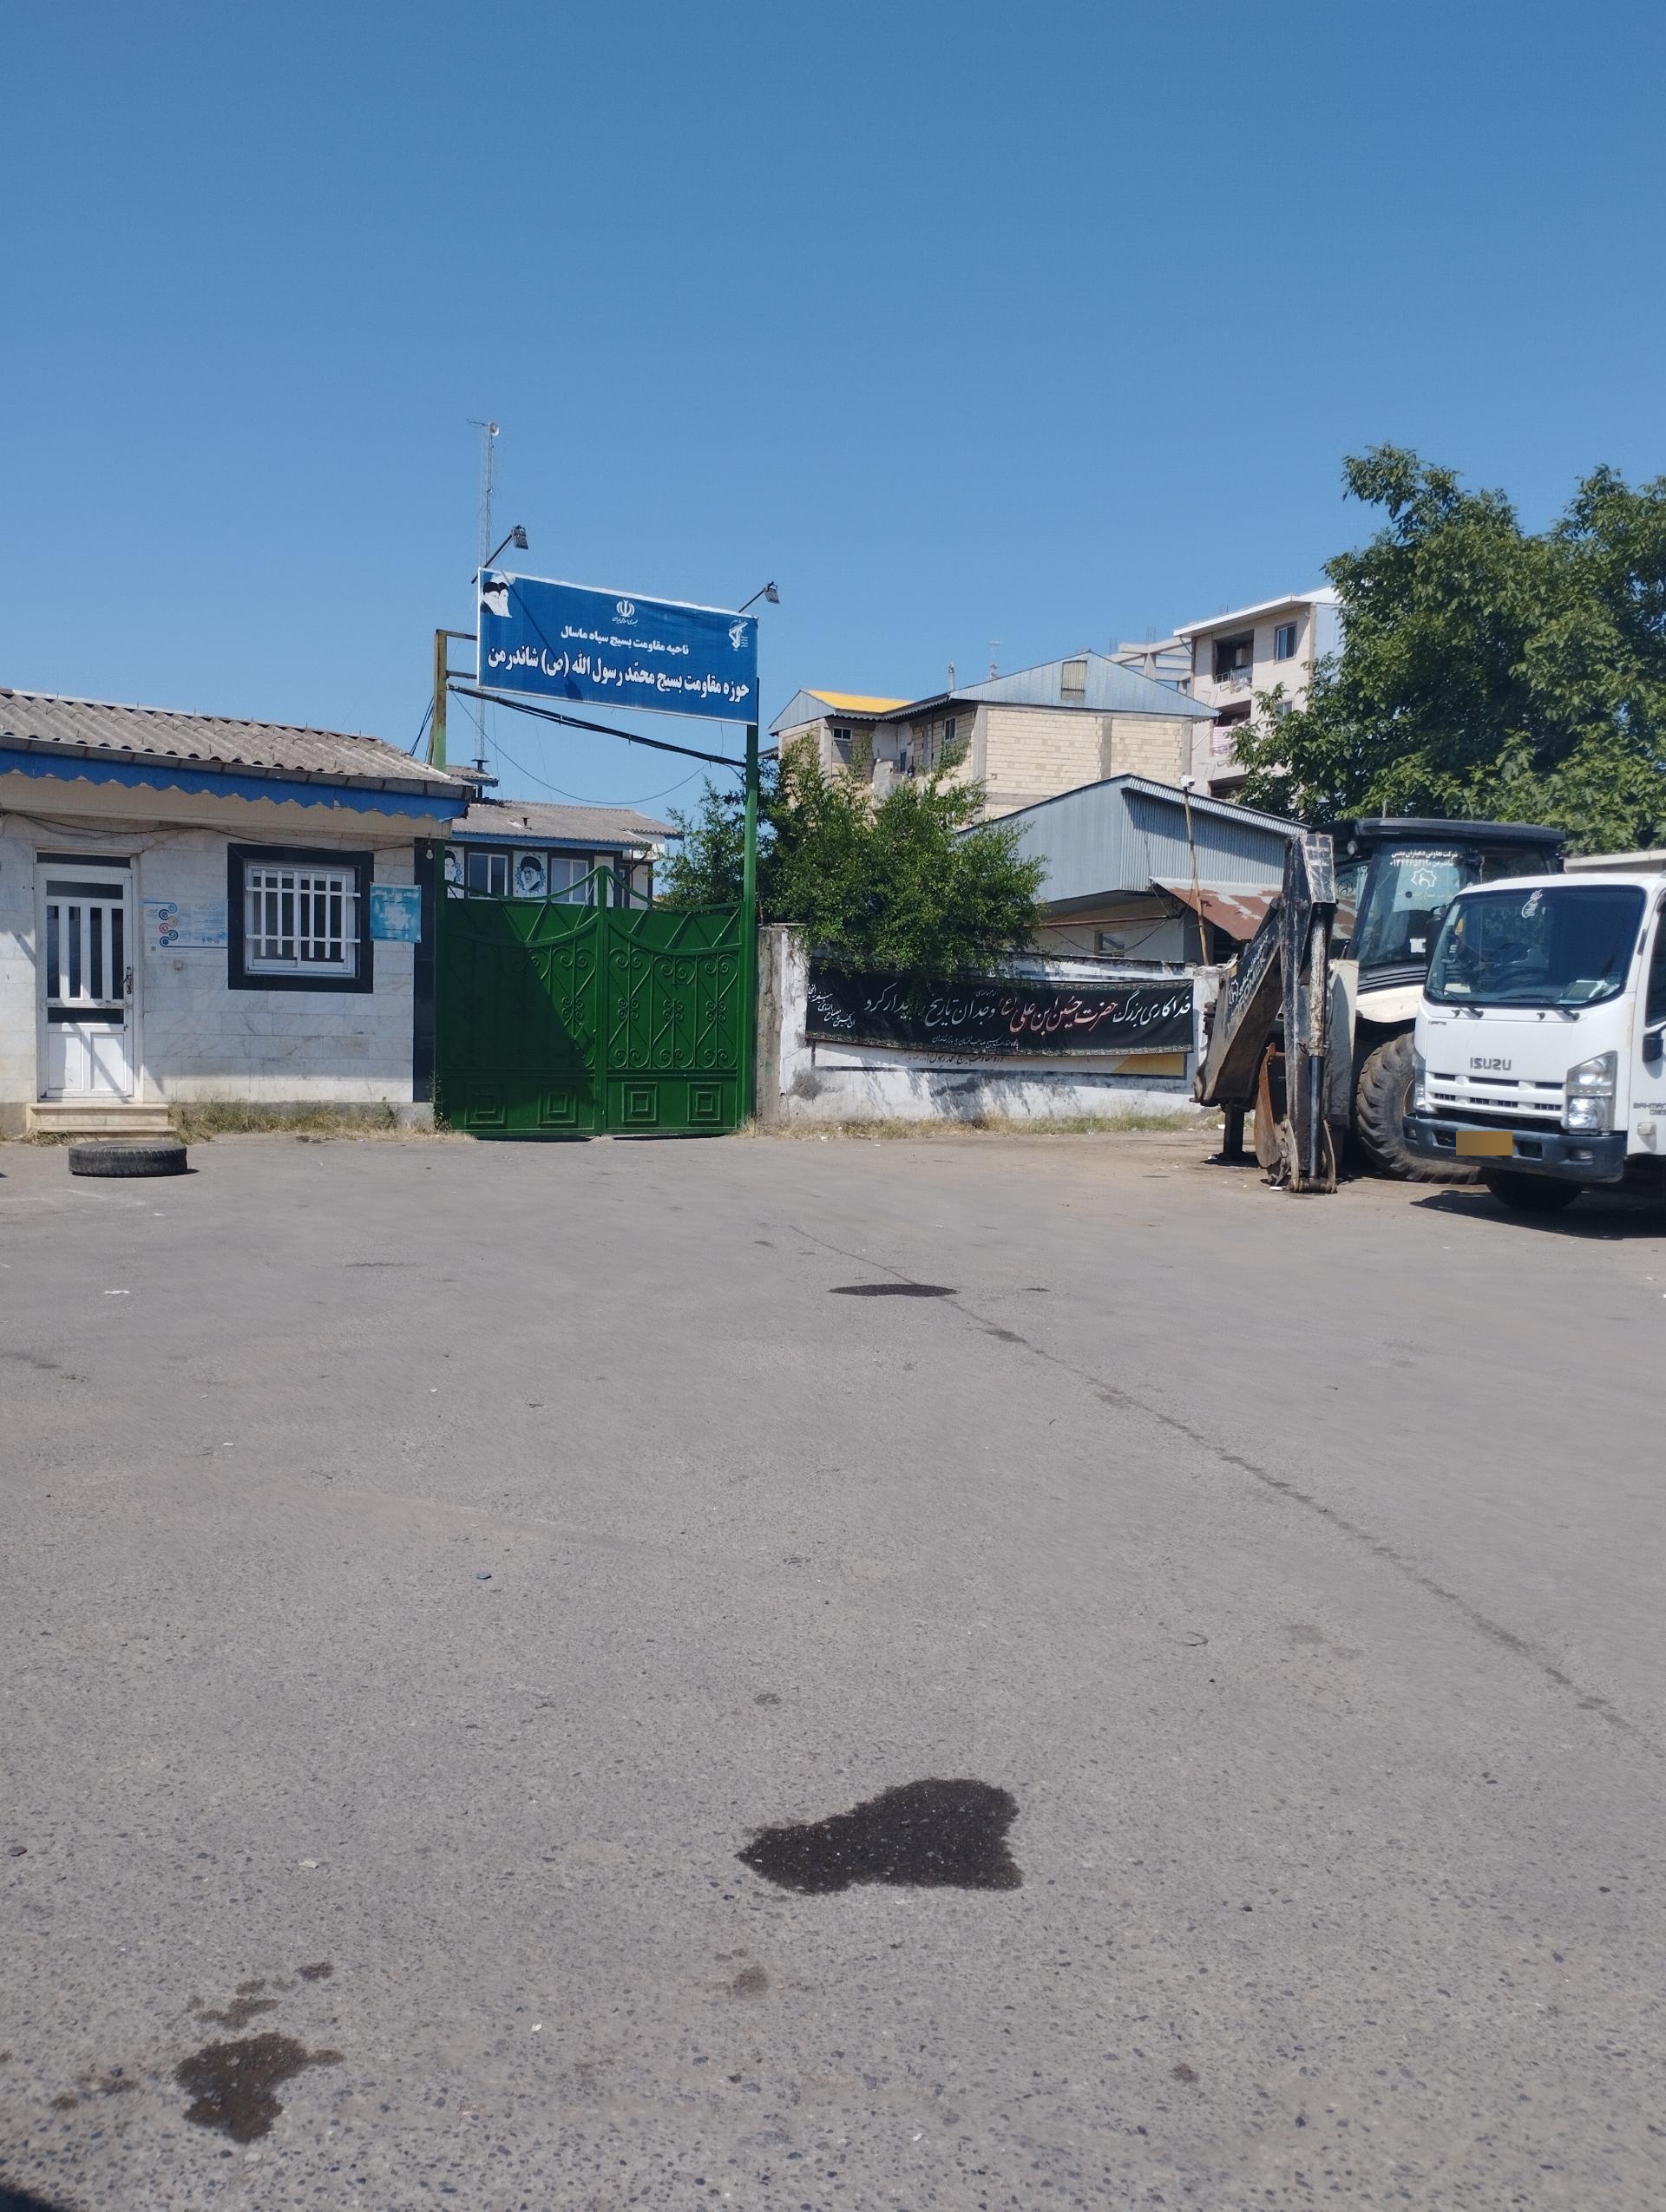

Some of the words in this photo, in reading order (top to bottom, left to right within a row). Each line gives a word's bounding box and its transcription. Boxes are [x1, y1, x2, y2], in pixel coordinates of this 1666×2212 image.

[561, 625, 588, 638] ماسال
[589, 631, 608, 645] سپاه
[609, 635, 632, 648] بسیج
[488, 645, 539, 670] شاندرمن
[633, 638, 666, 652] مقاومت
[666, 645, 690, 655] ناحیه
[541, 648, 569, 677] (ص)
[572, 650, 591, 676] الله
[592, 658, 623, 686] رسول
[656, 672, 683, 694] بسیج
[684, 673, 722, 697] مقاومت
[723, 680, 750, 703] حوزه
[863, 982, 898, 1012] کرد
[924, 992, 960, 1027] تاریخ
[1112, 989, 1143, 1027] بزرگ
[951, 998, 996, 1025] وجدان
[1009, 1002, 1035, 1033] علی
[1073, 1002, 1118, 1031] حضرت
[1139, 995, 1191, 1025] فداکاری
[1470, 1057, 1512, 1071] ISUZU
